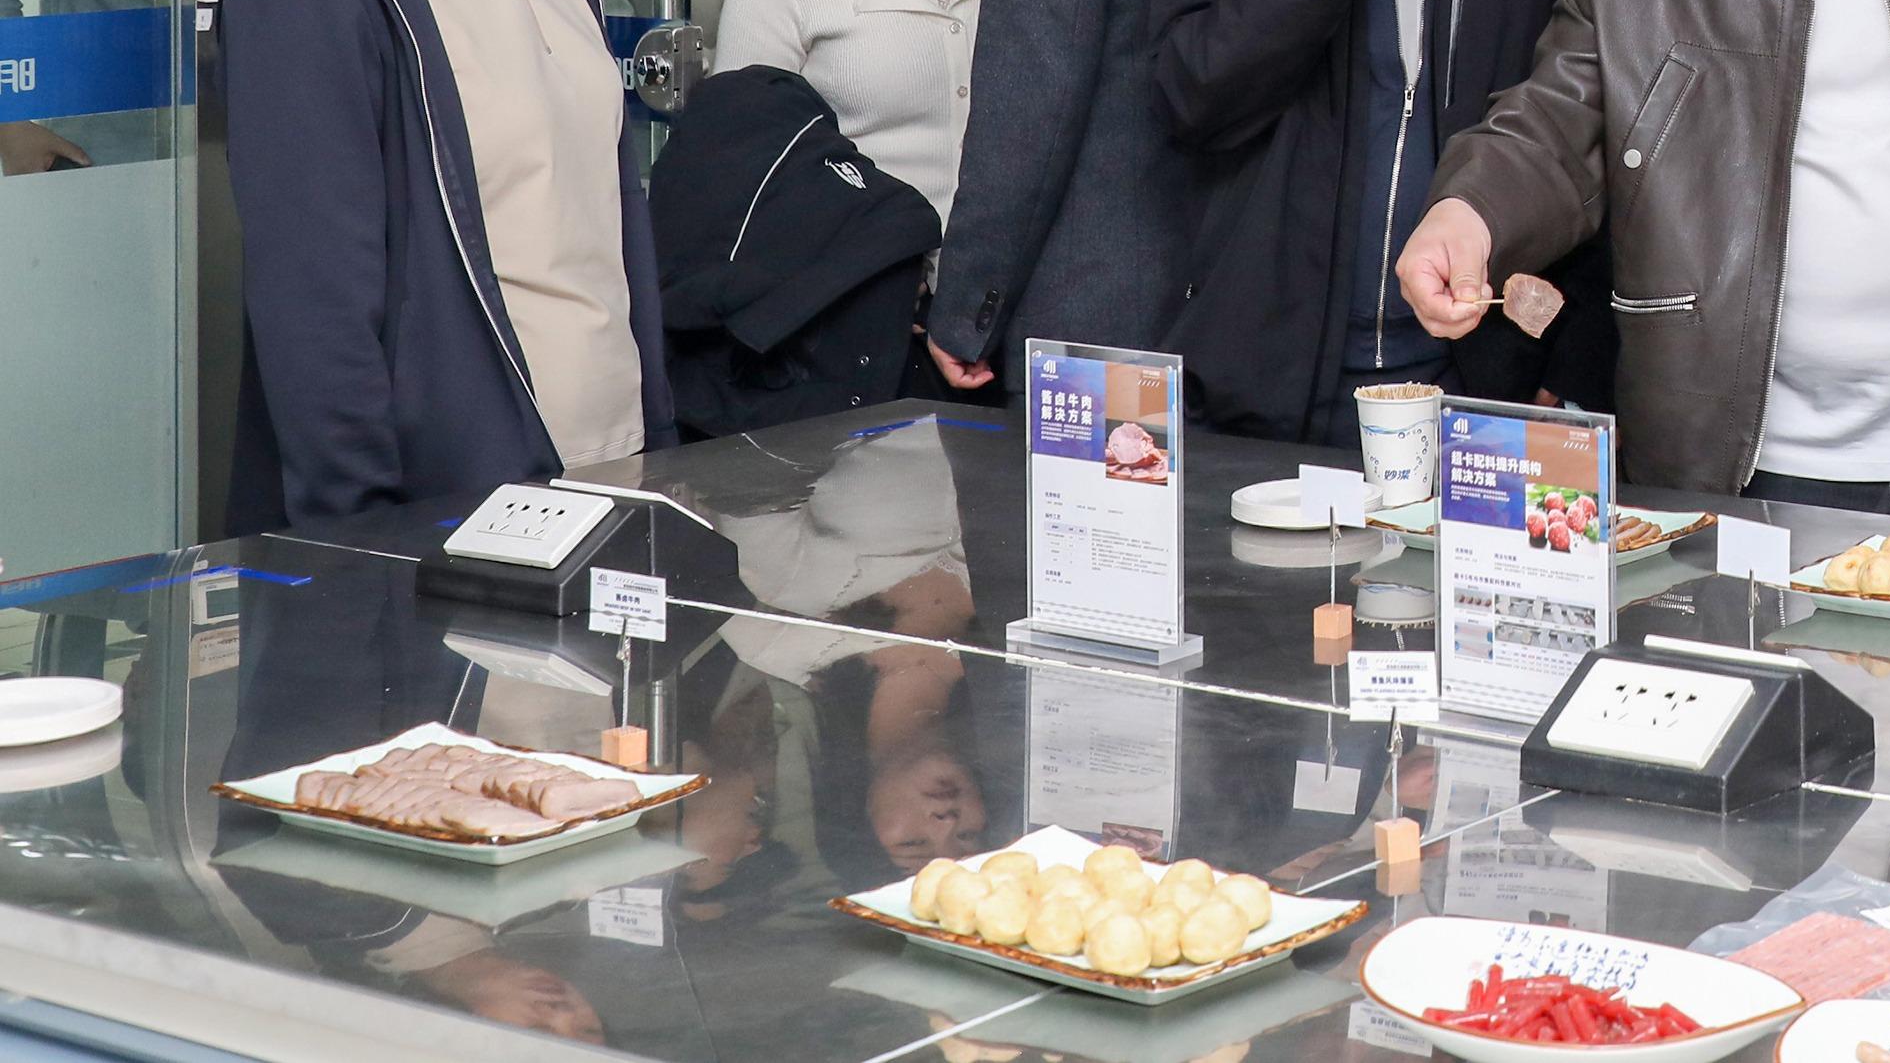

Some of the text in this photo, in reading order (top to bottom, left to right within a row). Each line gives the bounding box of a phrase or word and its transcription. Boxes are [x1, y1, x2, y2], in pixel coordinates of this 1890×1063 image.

[1040, 389, 1093, 411] 酱卤牛肉
[1040, 405, 1093, 426] 解决方案
[1450, 450, 1542, 477] 超卡配料提升质构
[1450, 467, 1497, 488] 解决方案
